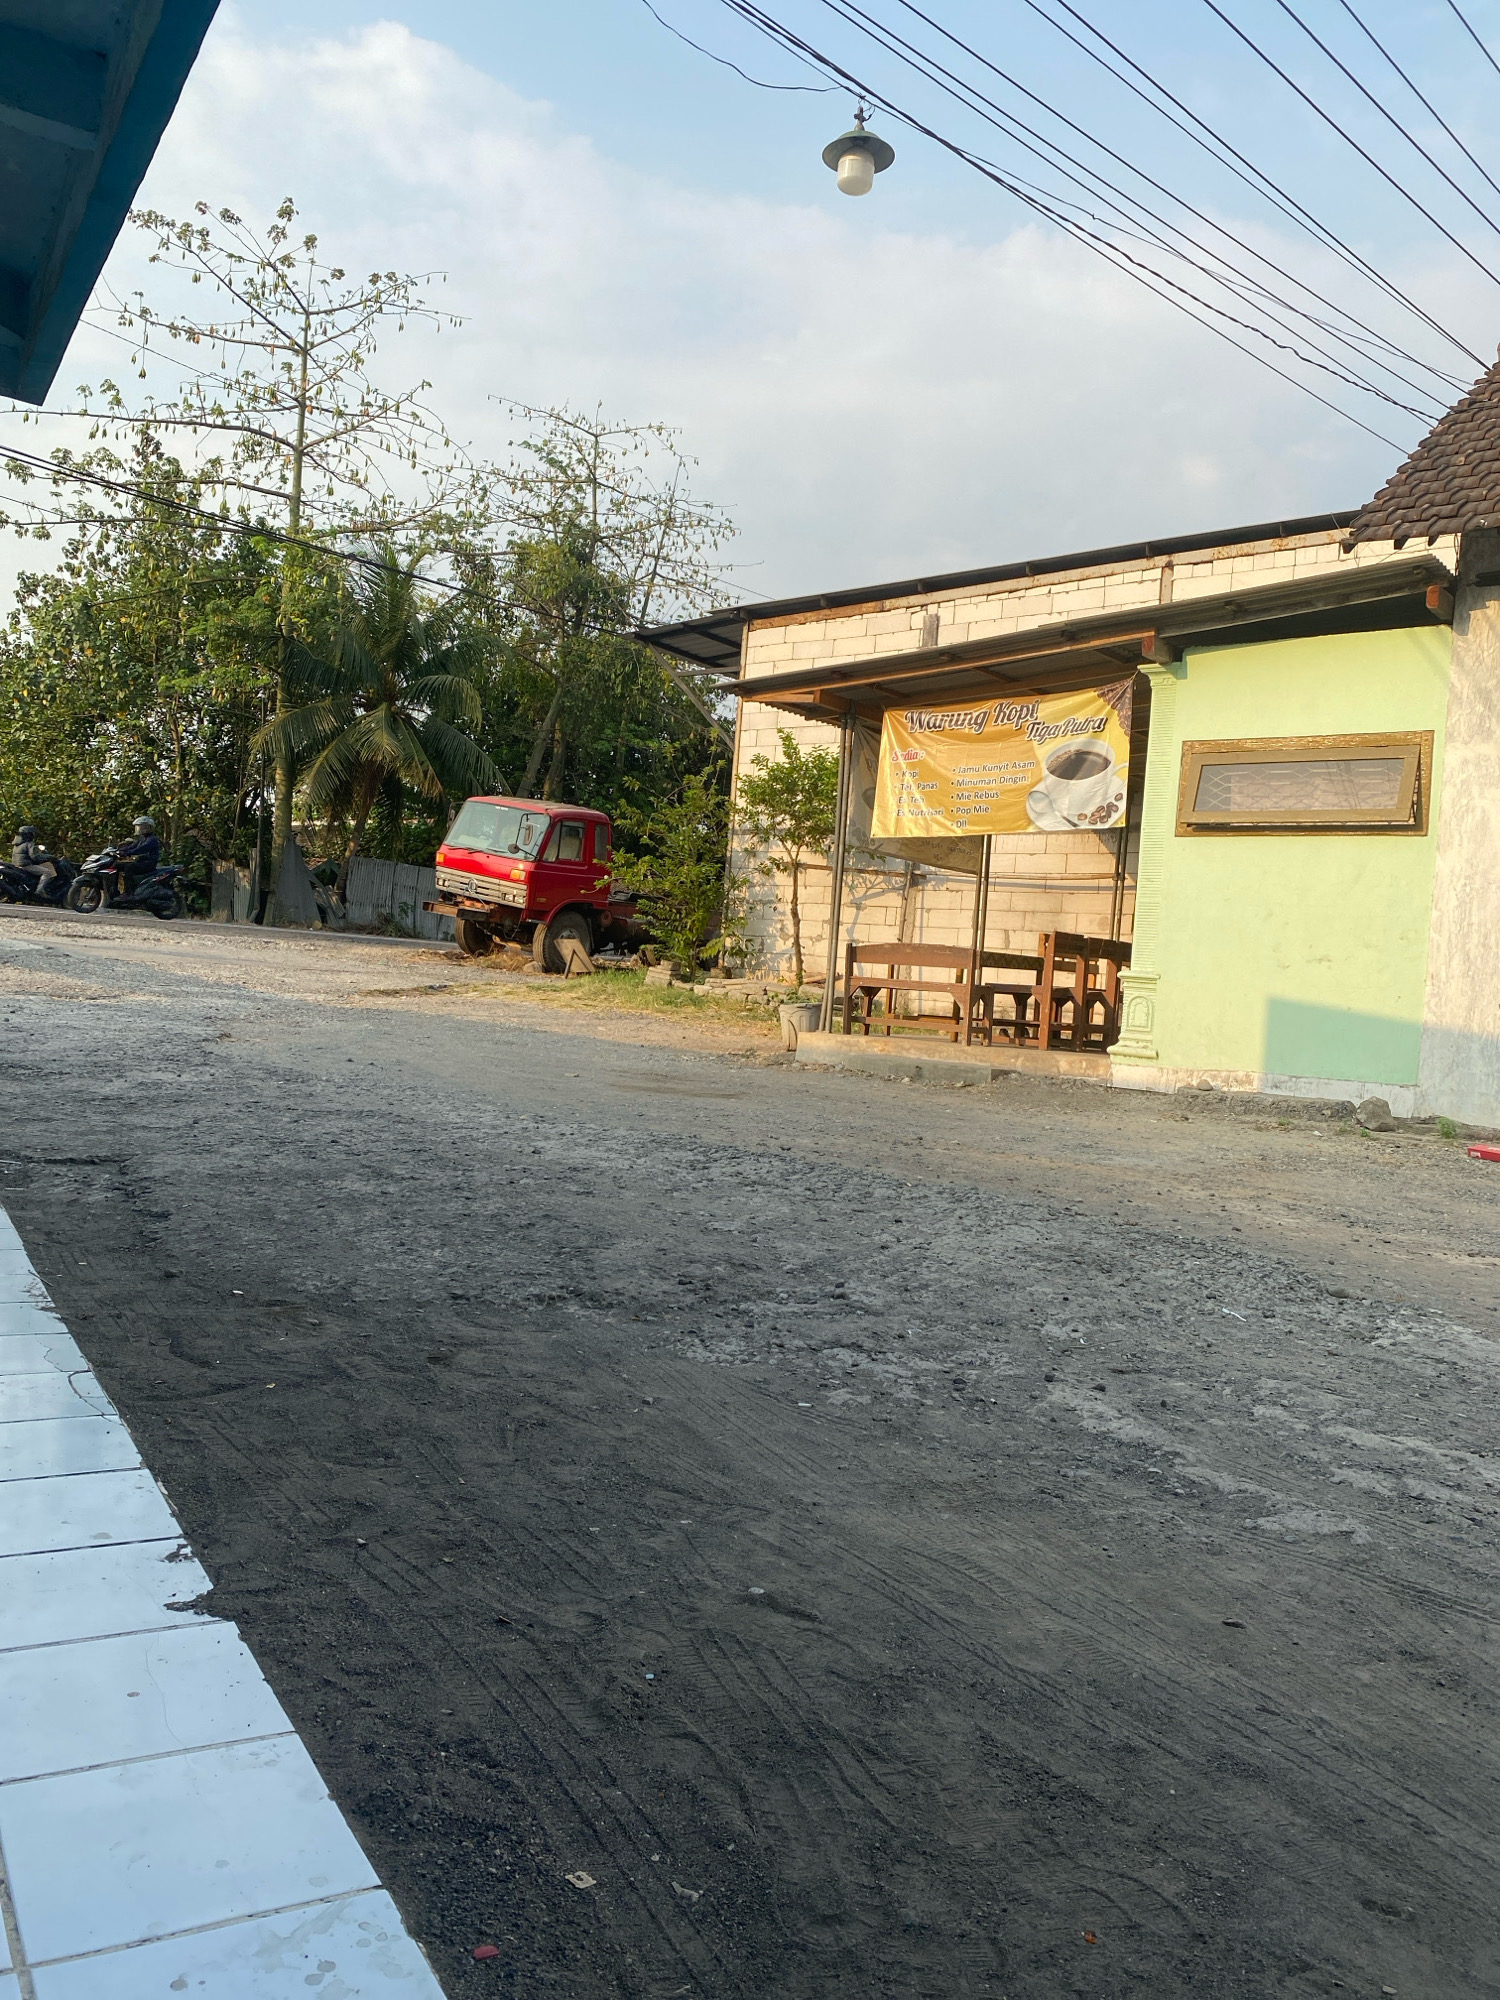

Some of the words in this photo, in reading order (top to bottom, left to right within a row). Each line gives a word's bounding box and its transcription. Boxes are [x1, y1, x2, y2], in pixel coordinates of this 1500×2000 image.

[906, 708, 989, 734] Warung
[992, 700, 1041, 729] Kopi
[1025, 719, 1060, 743] Tiga
[1060, 715, 1108, 736] Putra
[958, 766, 980, 774] Jamu
[982, 762, 1009, 773] Kunyit
[1011, 761, 1035, 770] Asam
[918, 782, 938, 790] Panas
[956, 778, 997, 787] Minuman
[999, 774, 1027, 784] Dingin
[956, 793, 972, 801] Mie
[974, 790, 1000, 800] Rebus
[956, 807, 971, 816] Pop
[973, 805, 990, 814] Mie
